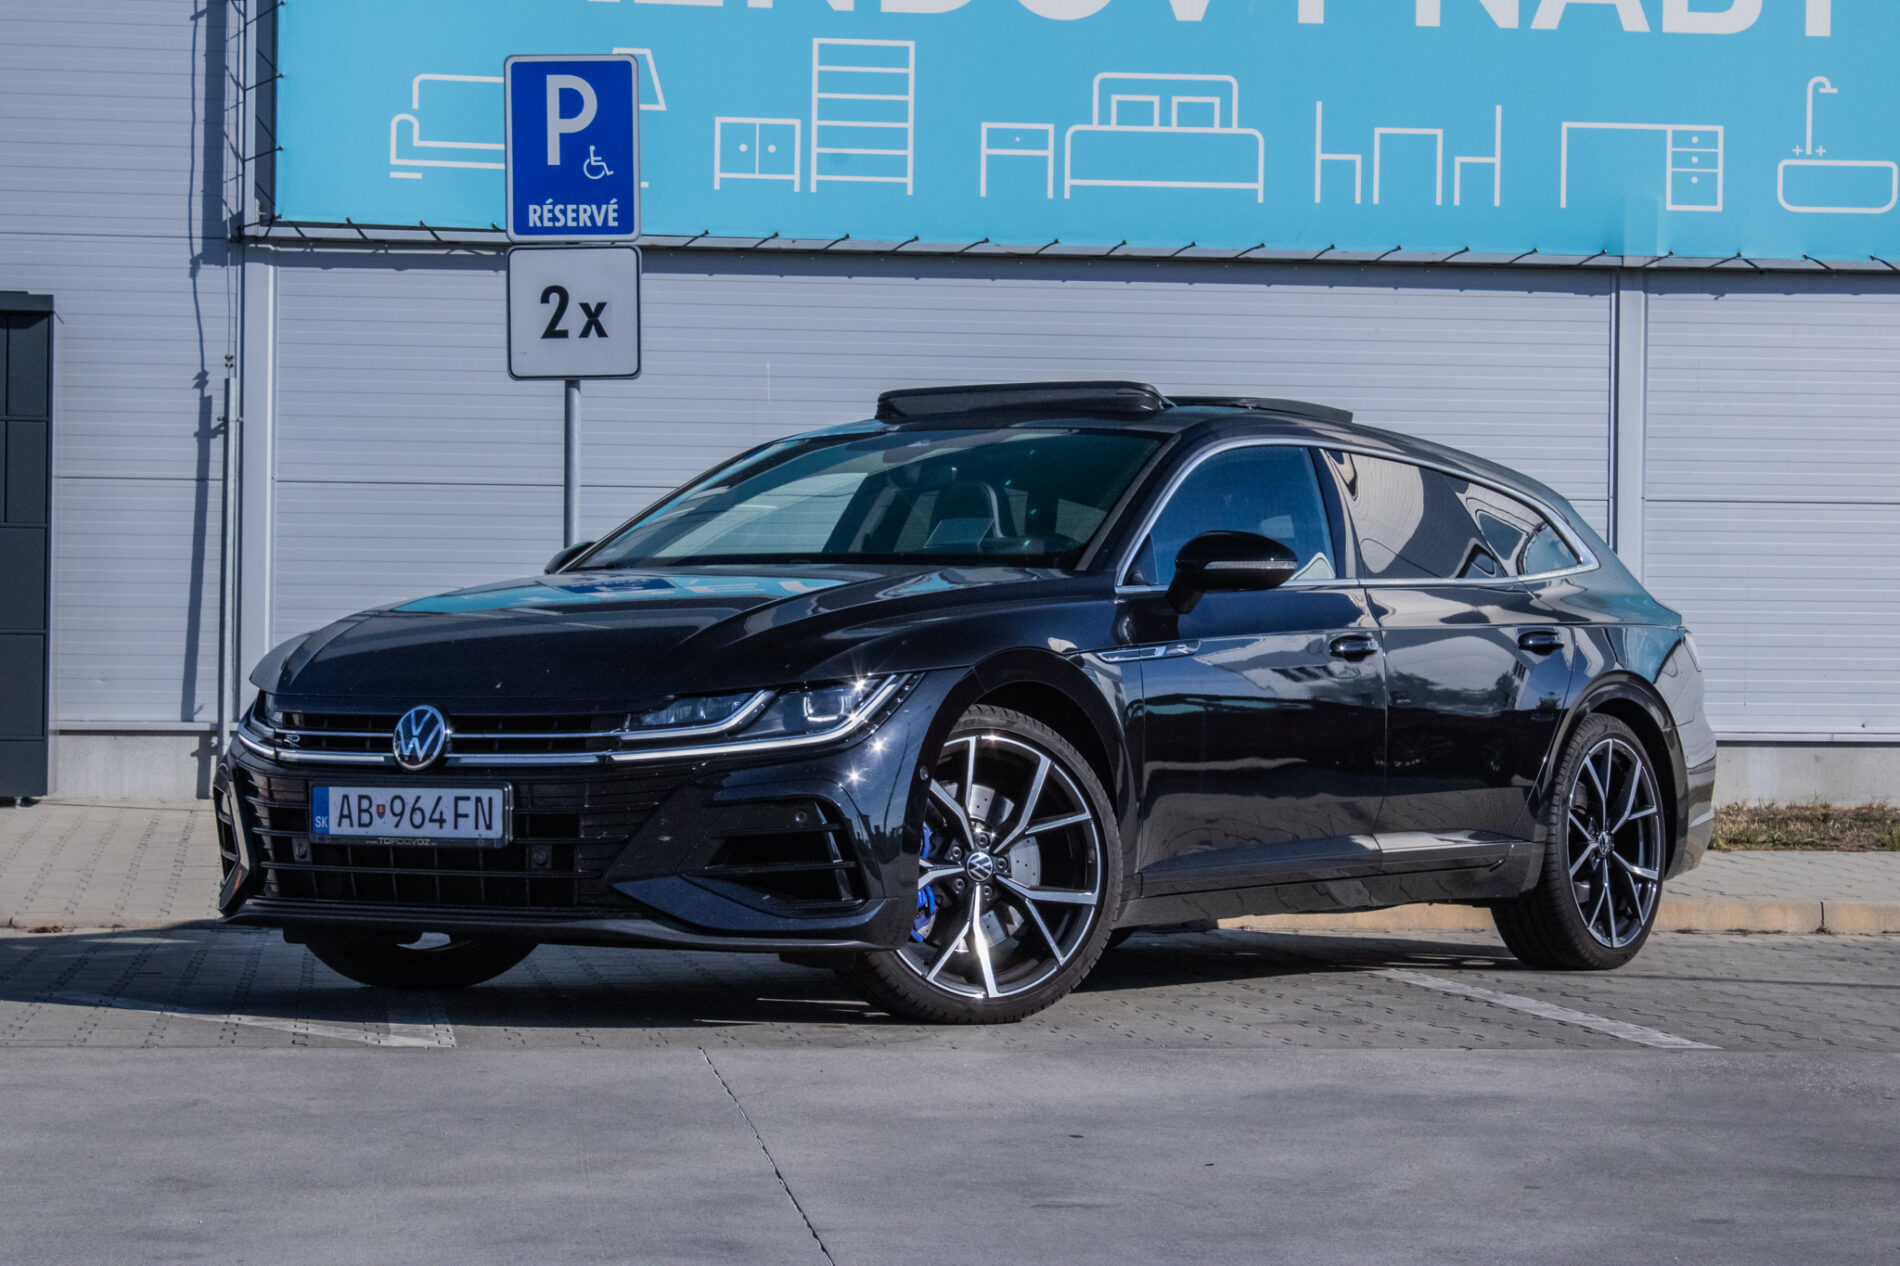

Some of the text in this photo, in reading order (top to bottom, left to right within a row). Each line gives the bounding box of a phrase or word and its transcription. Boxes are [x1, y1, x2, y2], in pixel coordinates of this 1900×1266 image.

[546, 74, 598, 166] P
[528, 197, 619, 228] RÉSERVÉ
[539, 285, 609, 340] 2x
[315, 815, 328, 829] SK
